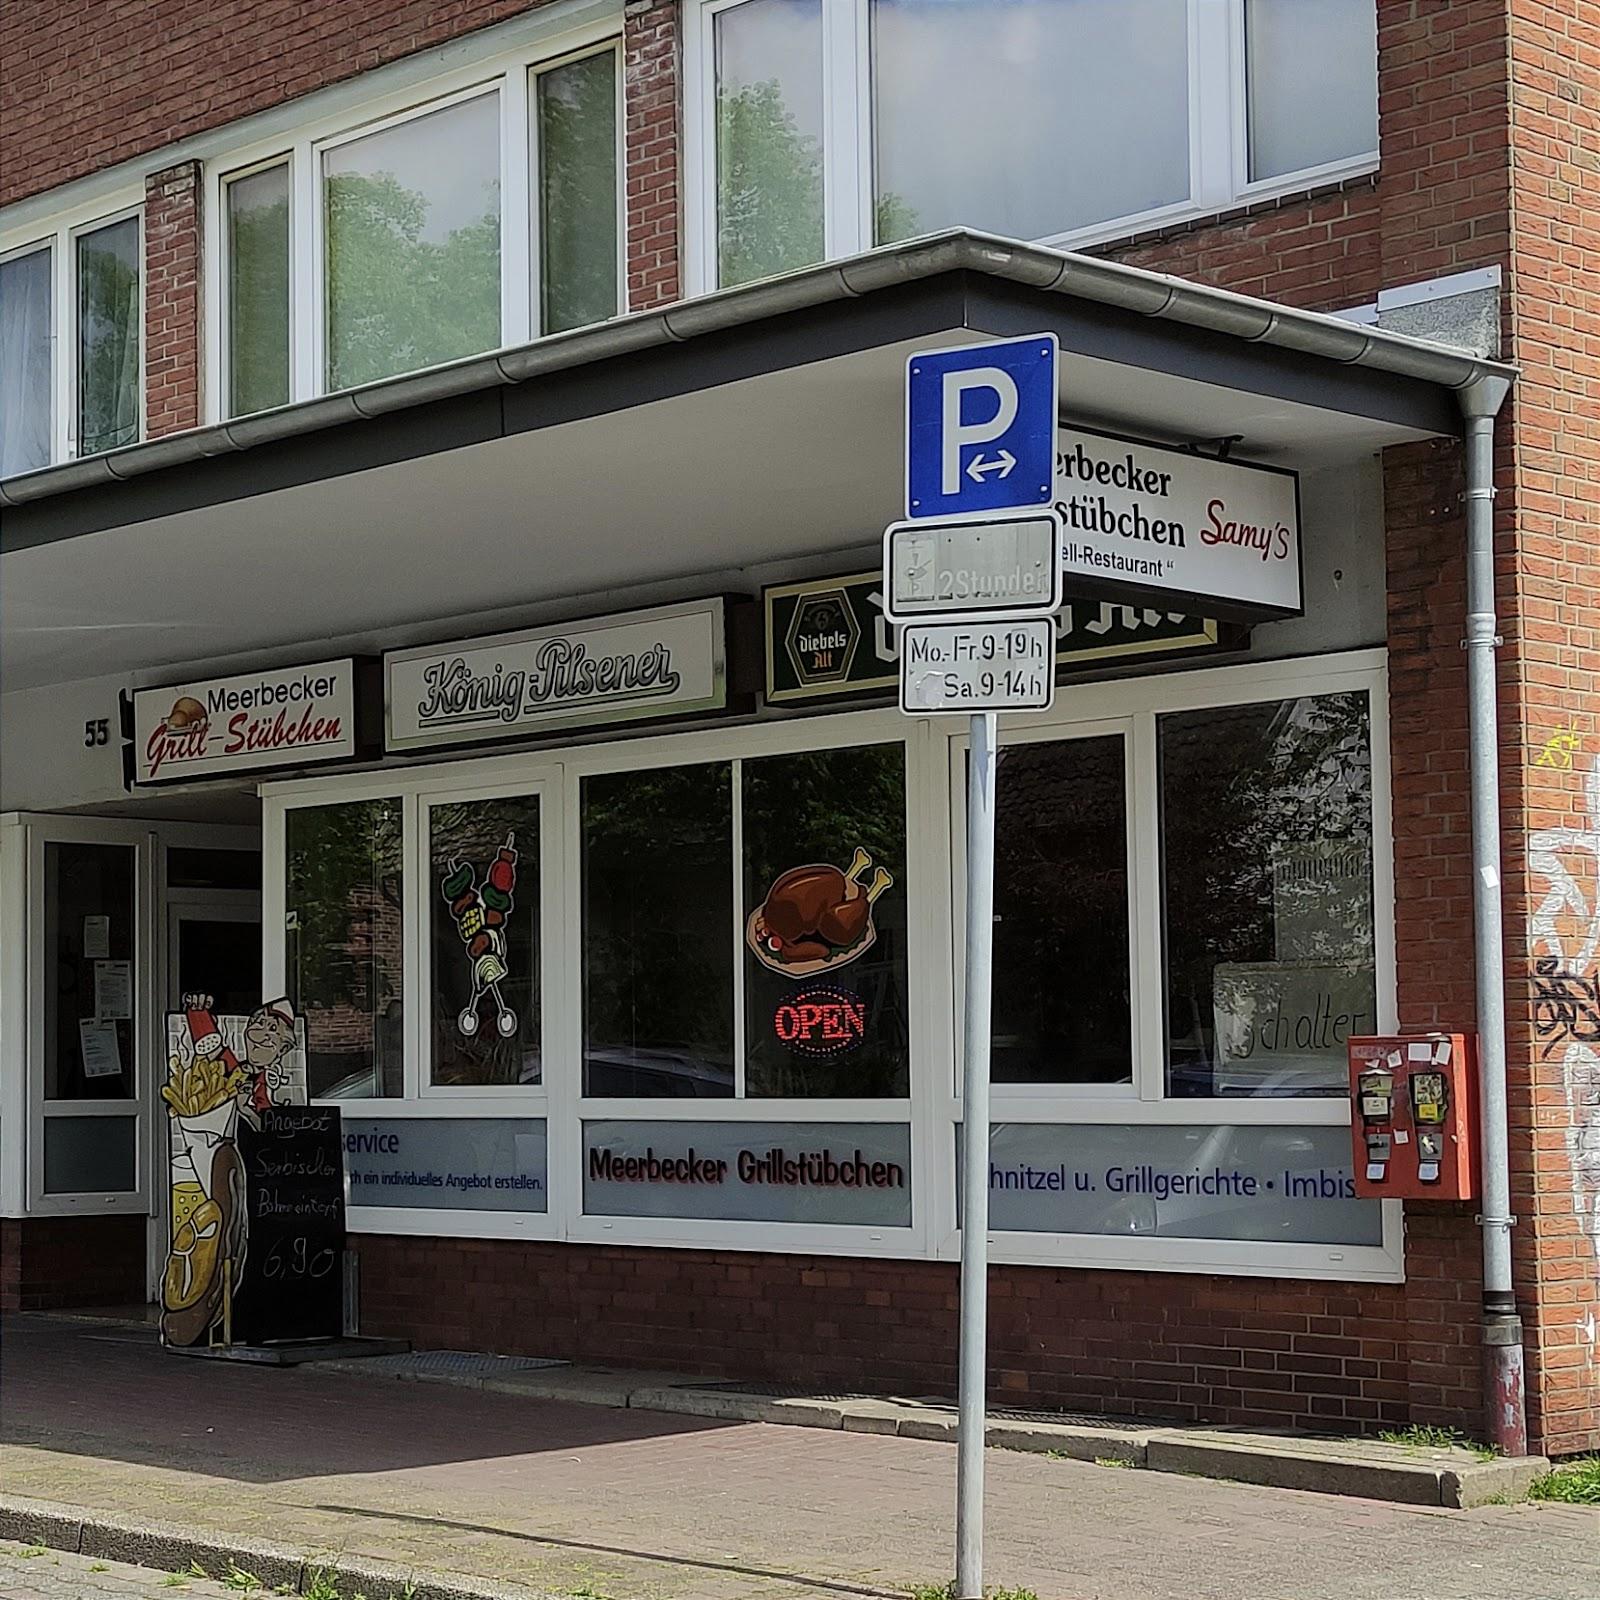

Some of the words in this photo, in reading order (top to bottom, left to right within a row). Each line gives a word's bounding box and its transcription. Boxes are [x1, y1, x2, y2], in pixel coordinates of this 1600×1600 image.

[942, 367, 1019, 495] P
[1055, 495, 1185, 547] stübchen
[208, 675, 337, 714] Meerbecker
[84, 718, 109, 747] 55
[775, 1004, 865, 1040] OPEN
[364, 1171, 379, 1185] ein
[382, 1170, 443, 1187] individuelles
[446, 1173, 492, 1191] Angebot
[495, 1174, 543, 1190] erstellen.
[589, 1147, 727, 1184] Meerbecker
[737, 1149, 904, 1189] Grillstübchen
[1074, 1174, 1096, 1192] u.
[1105, 1167, 1257, 1201] Grillgerichte
[263, 1236, 336, 1280] 6,90
